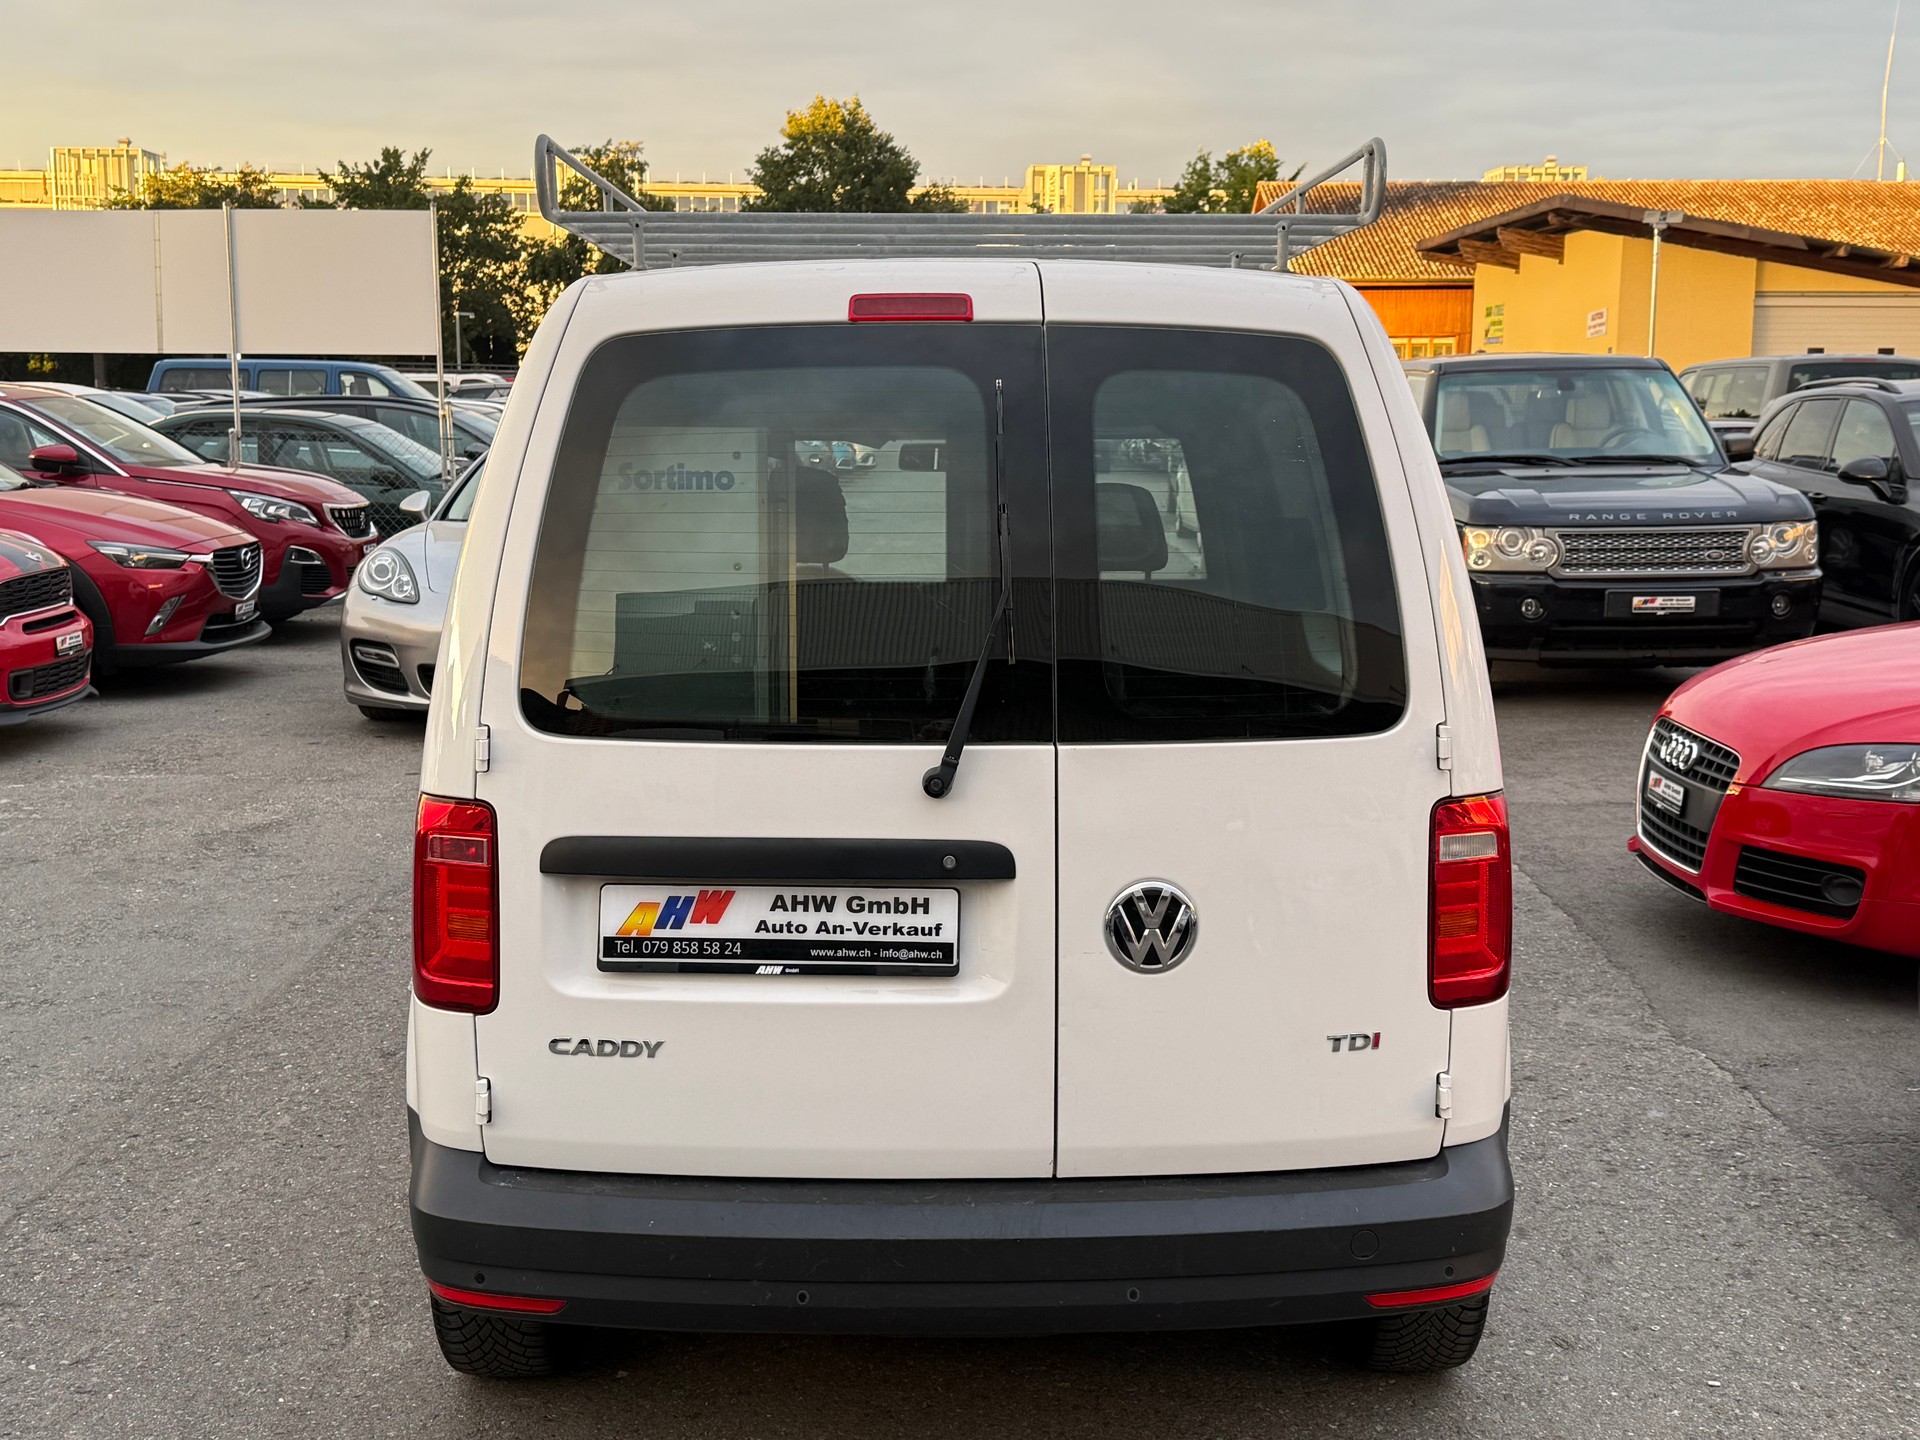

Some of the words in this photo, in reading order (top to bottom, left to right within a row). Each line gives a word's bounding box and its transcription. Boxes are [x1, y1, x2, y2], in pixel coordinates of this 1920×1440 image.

[618, 461, 736, 491] Sortimo
[1568, 513, 1647, 521] RANGE
[1662, 510, 1738, 519] ROVER
[615, 889, 737, 936] AHW
[769, 894, 837, 913] AHW
[846, 895, 930, 915] GmbH
[754, 919, 808, 934] Auto
[815, 920, 943, 937] An-Verkauf
[614, 940, 638, 954] Tel.
[642, 940, 669, 954] 079
[672, 941, 699, 955] 858
[702, 941, 720, 955] 58
[724, 941, 742, 955] 24
[810, 948, 871, 958] www.ahw.ch
[879, 948, 943, 960] info@ahw.ch
[755, 965, 784, 975] AHW
[548, 1036, 666, 1059] CADDY
[1326, 1030, 1382, 1053] TDI
